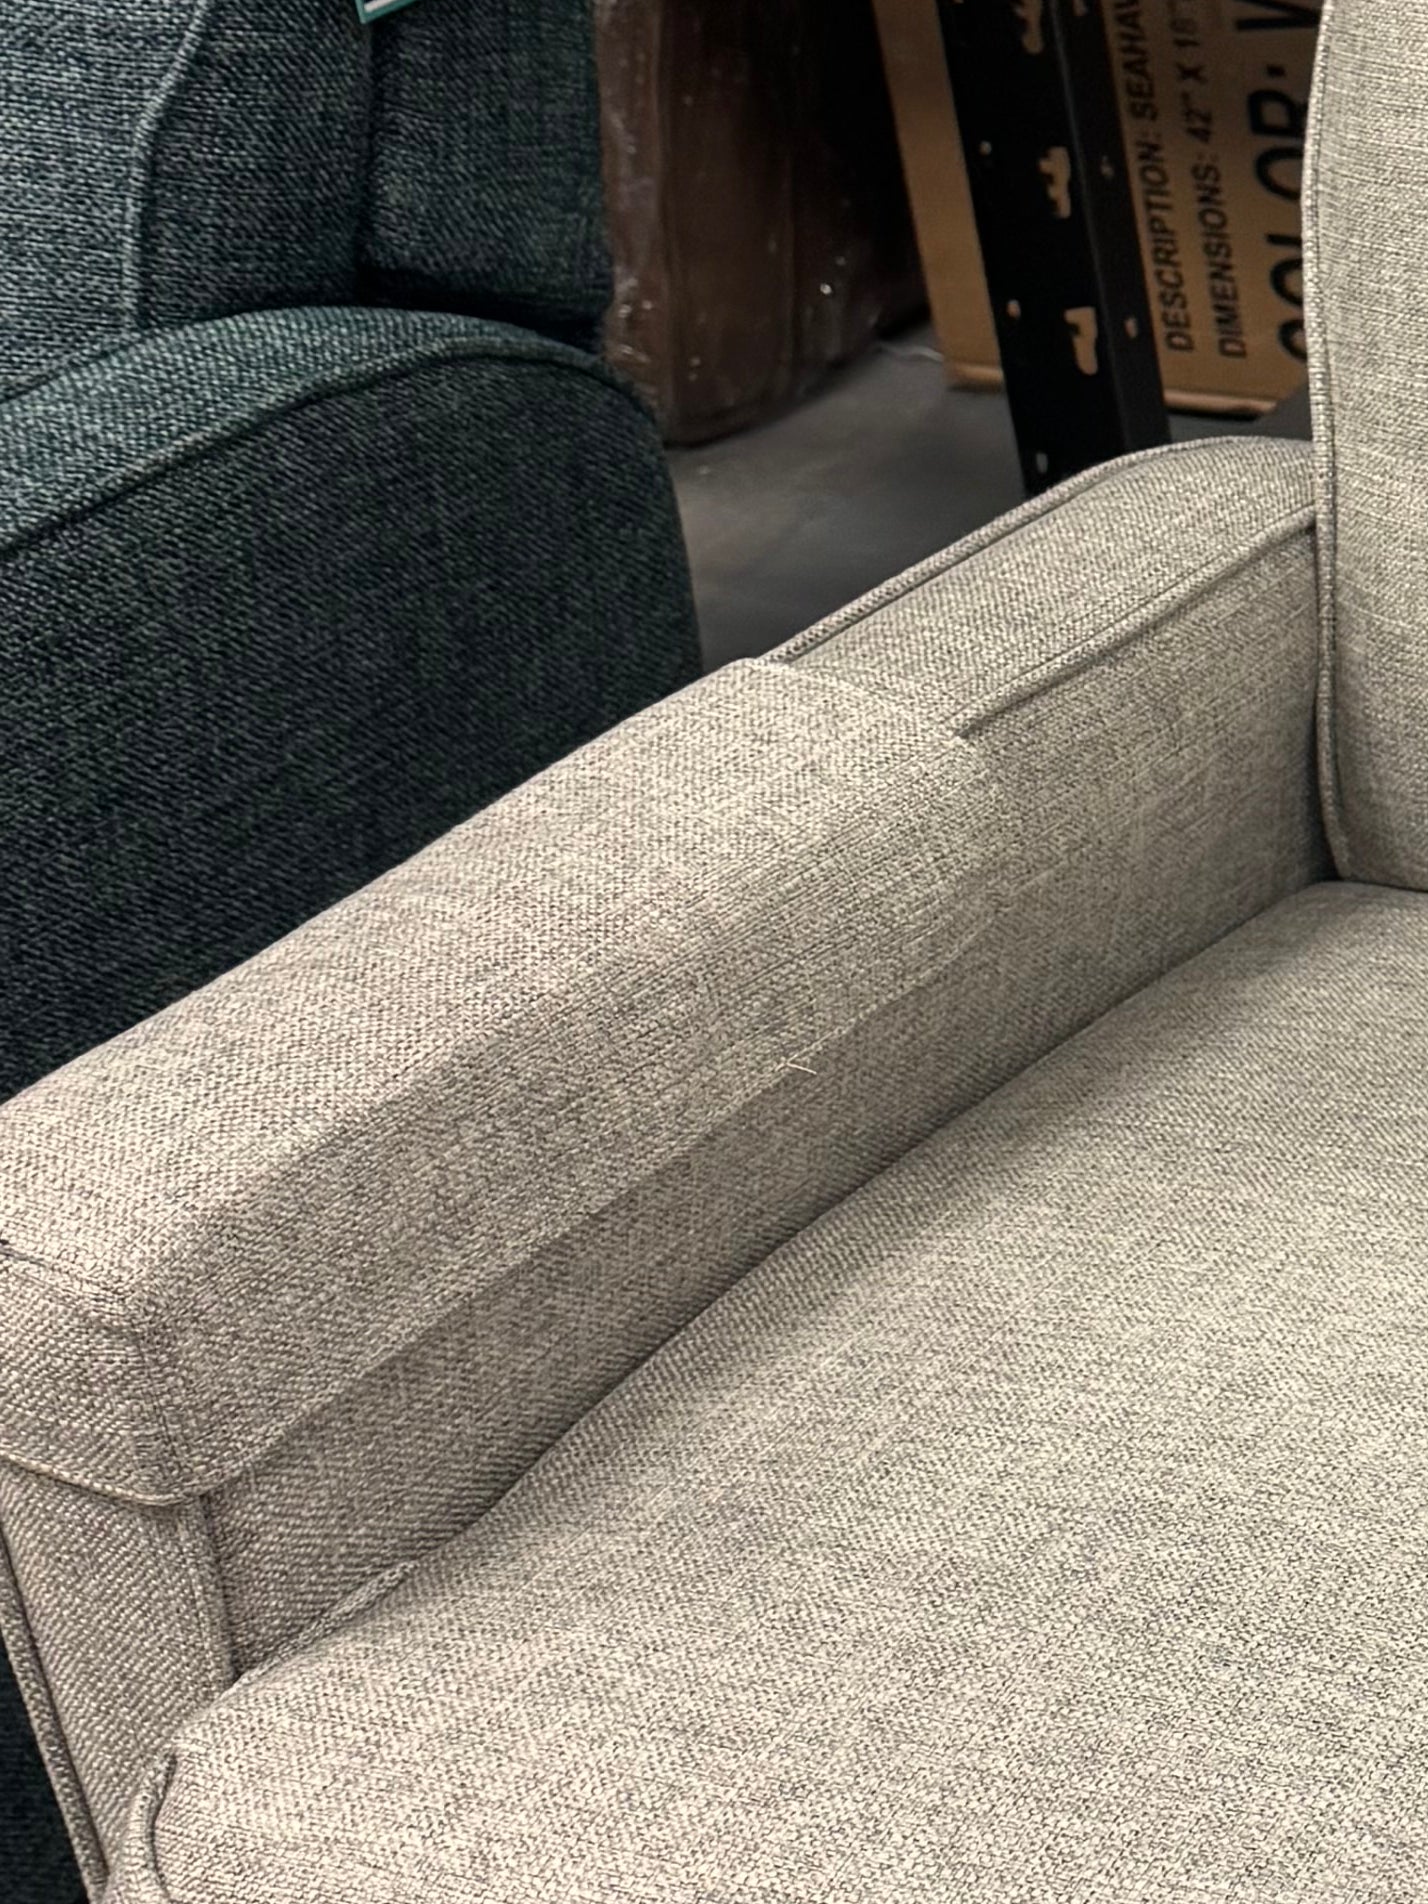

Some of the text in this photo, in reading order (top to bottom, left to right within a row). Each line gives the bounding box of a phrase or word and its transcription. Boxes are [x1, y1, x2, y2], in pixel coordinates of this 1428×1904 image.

[1177, 63, 1207, 85] X
[1138, 132, 1195, 352] DESCRIPTION:
[1193, 154, 1247, 359] DIMENSIONS:
